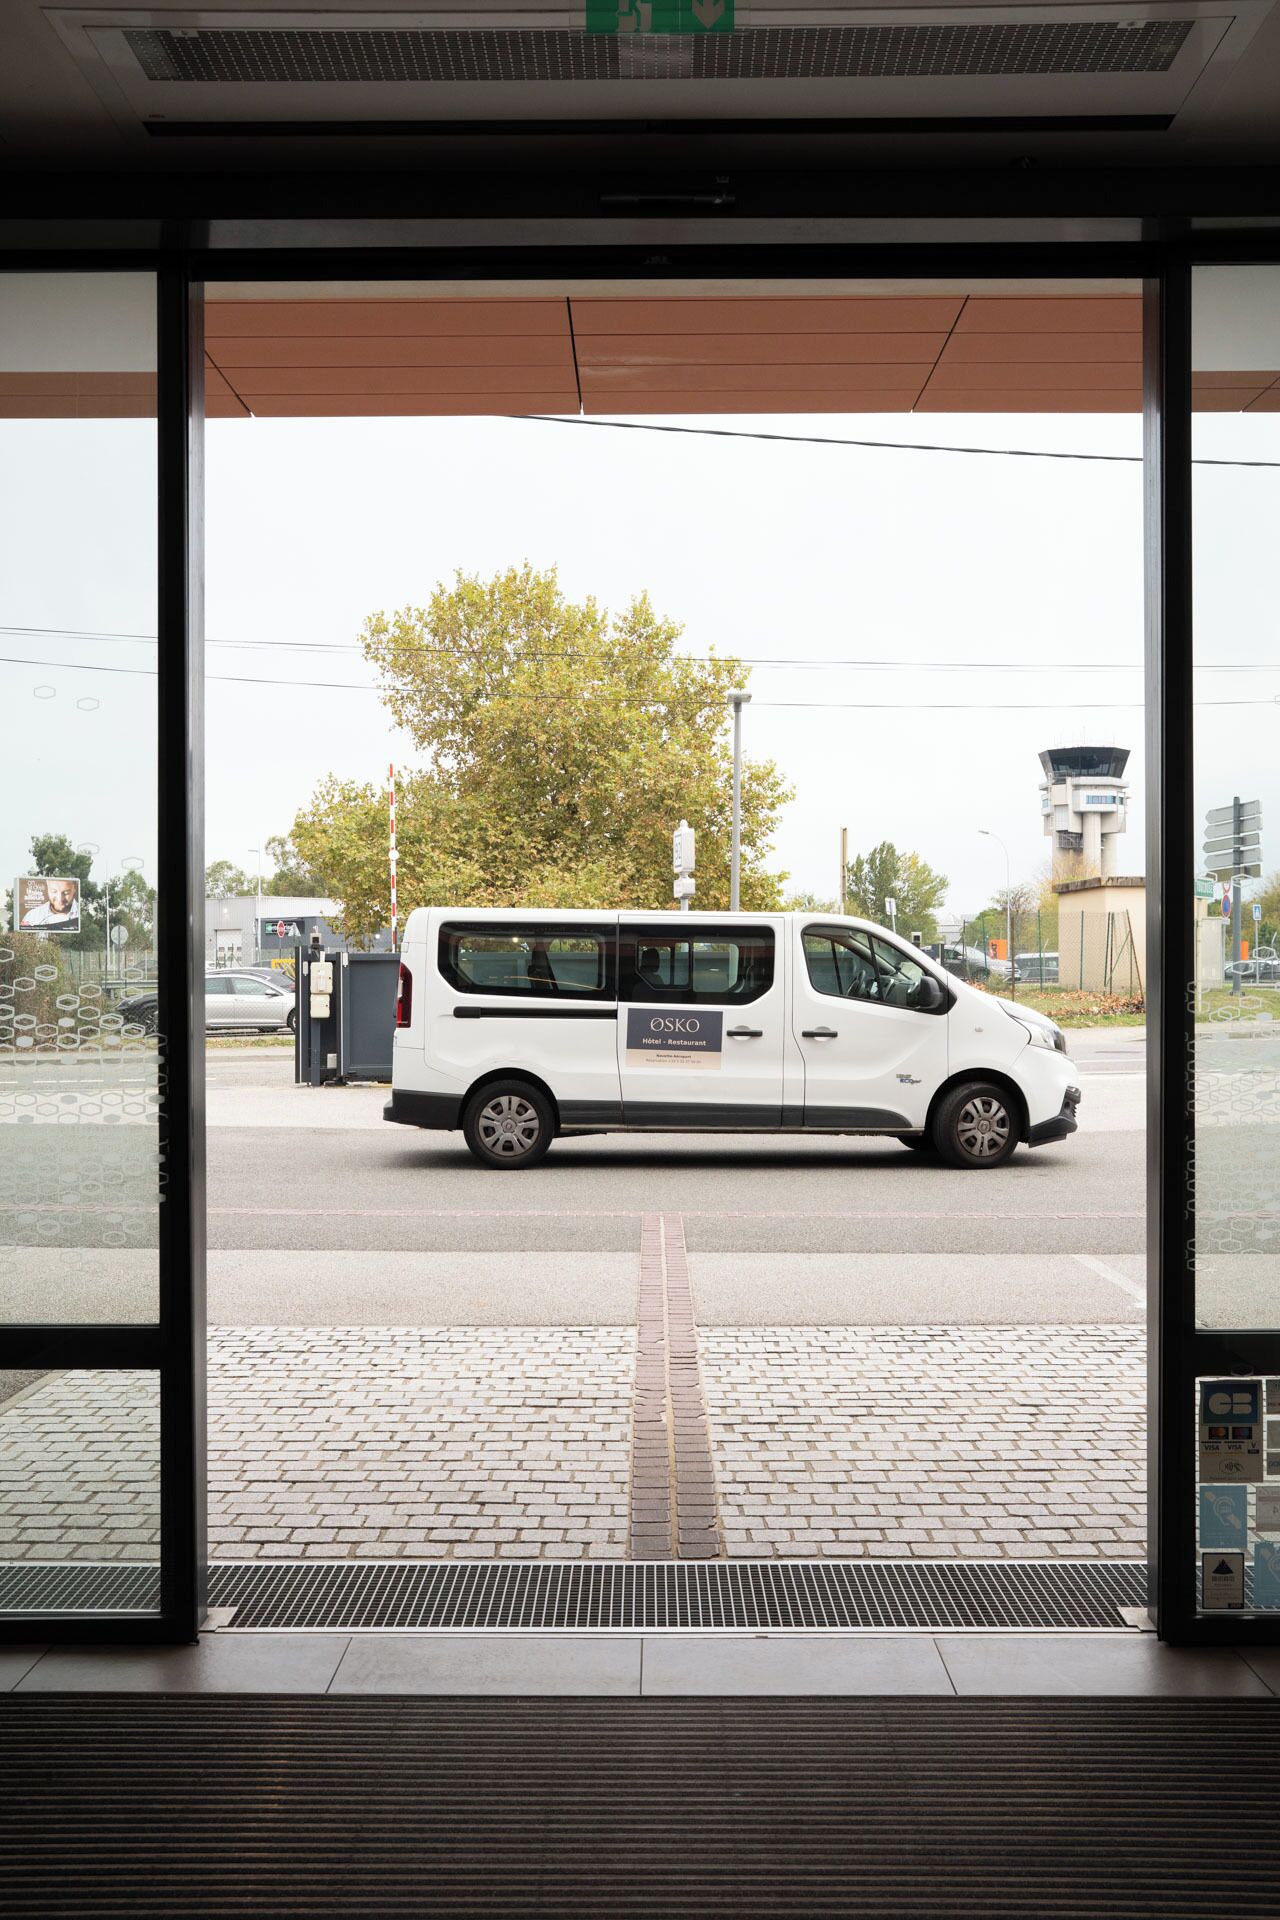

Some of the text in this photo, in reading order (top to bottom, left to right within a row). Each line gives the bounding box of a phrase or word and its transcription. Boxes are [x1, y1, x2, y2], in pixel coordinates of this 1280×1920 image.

[650, 1017, 700, 1033] ØSKO
[642, 1037, 662, 1045] Hôtel
[667, 1038, 706, 1046] Restaurant
